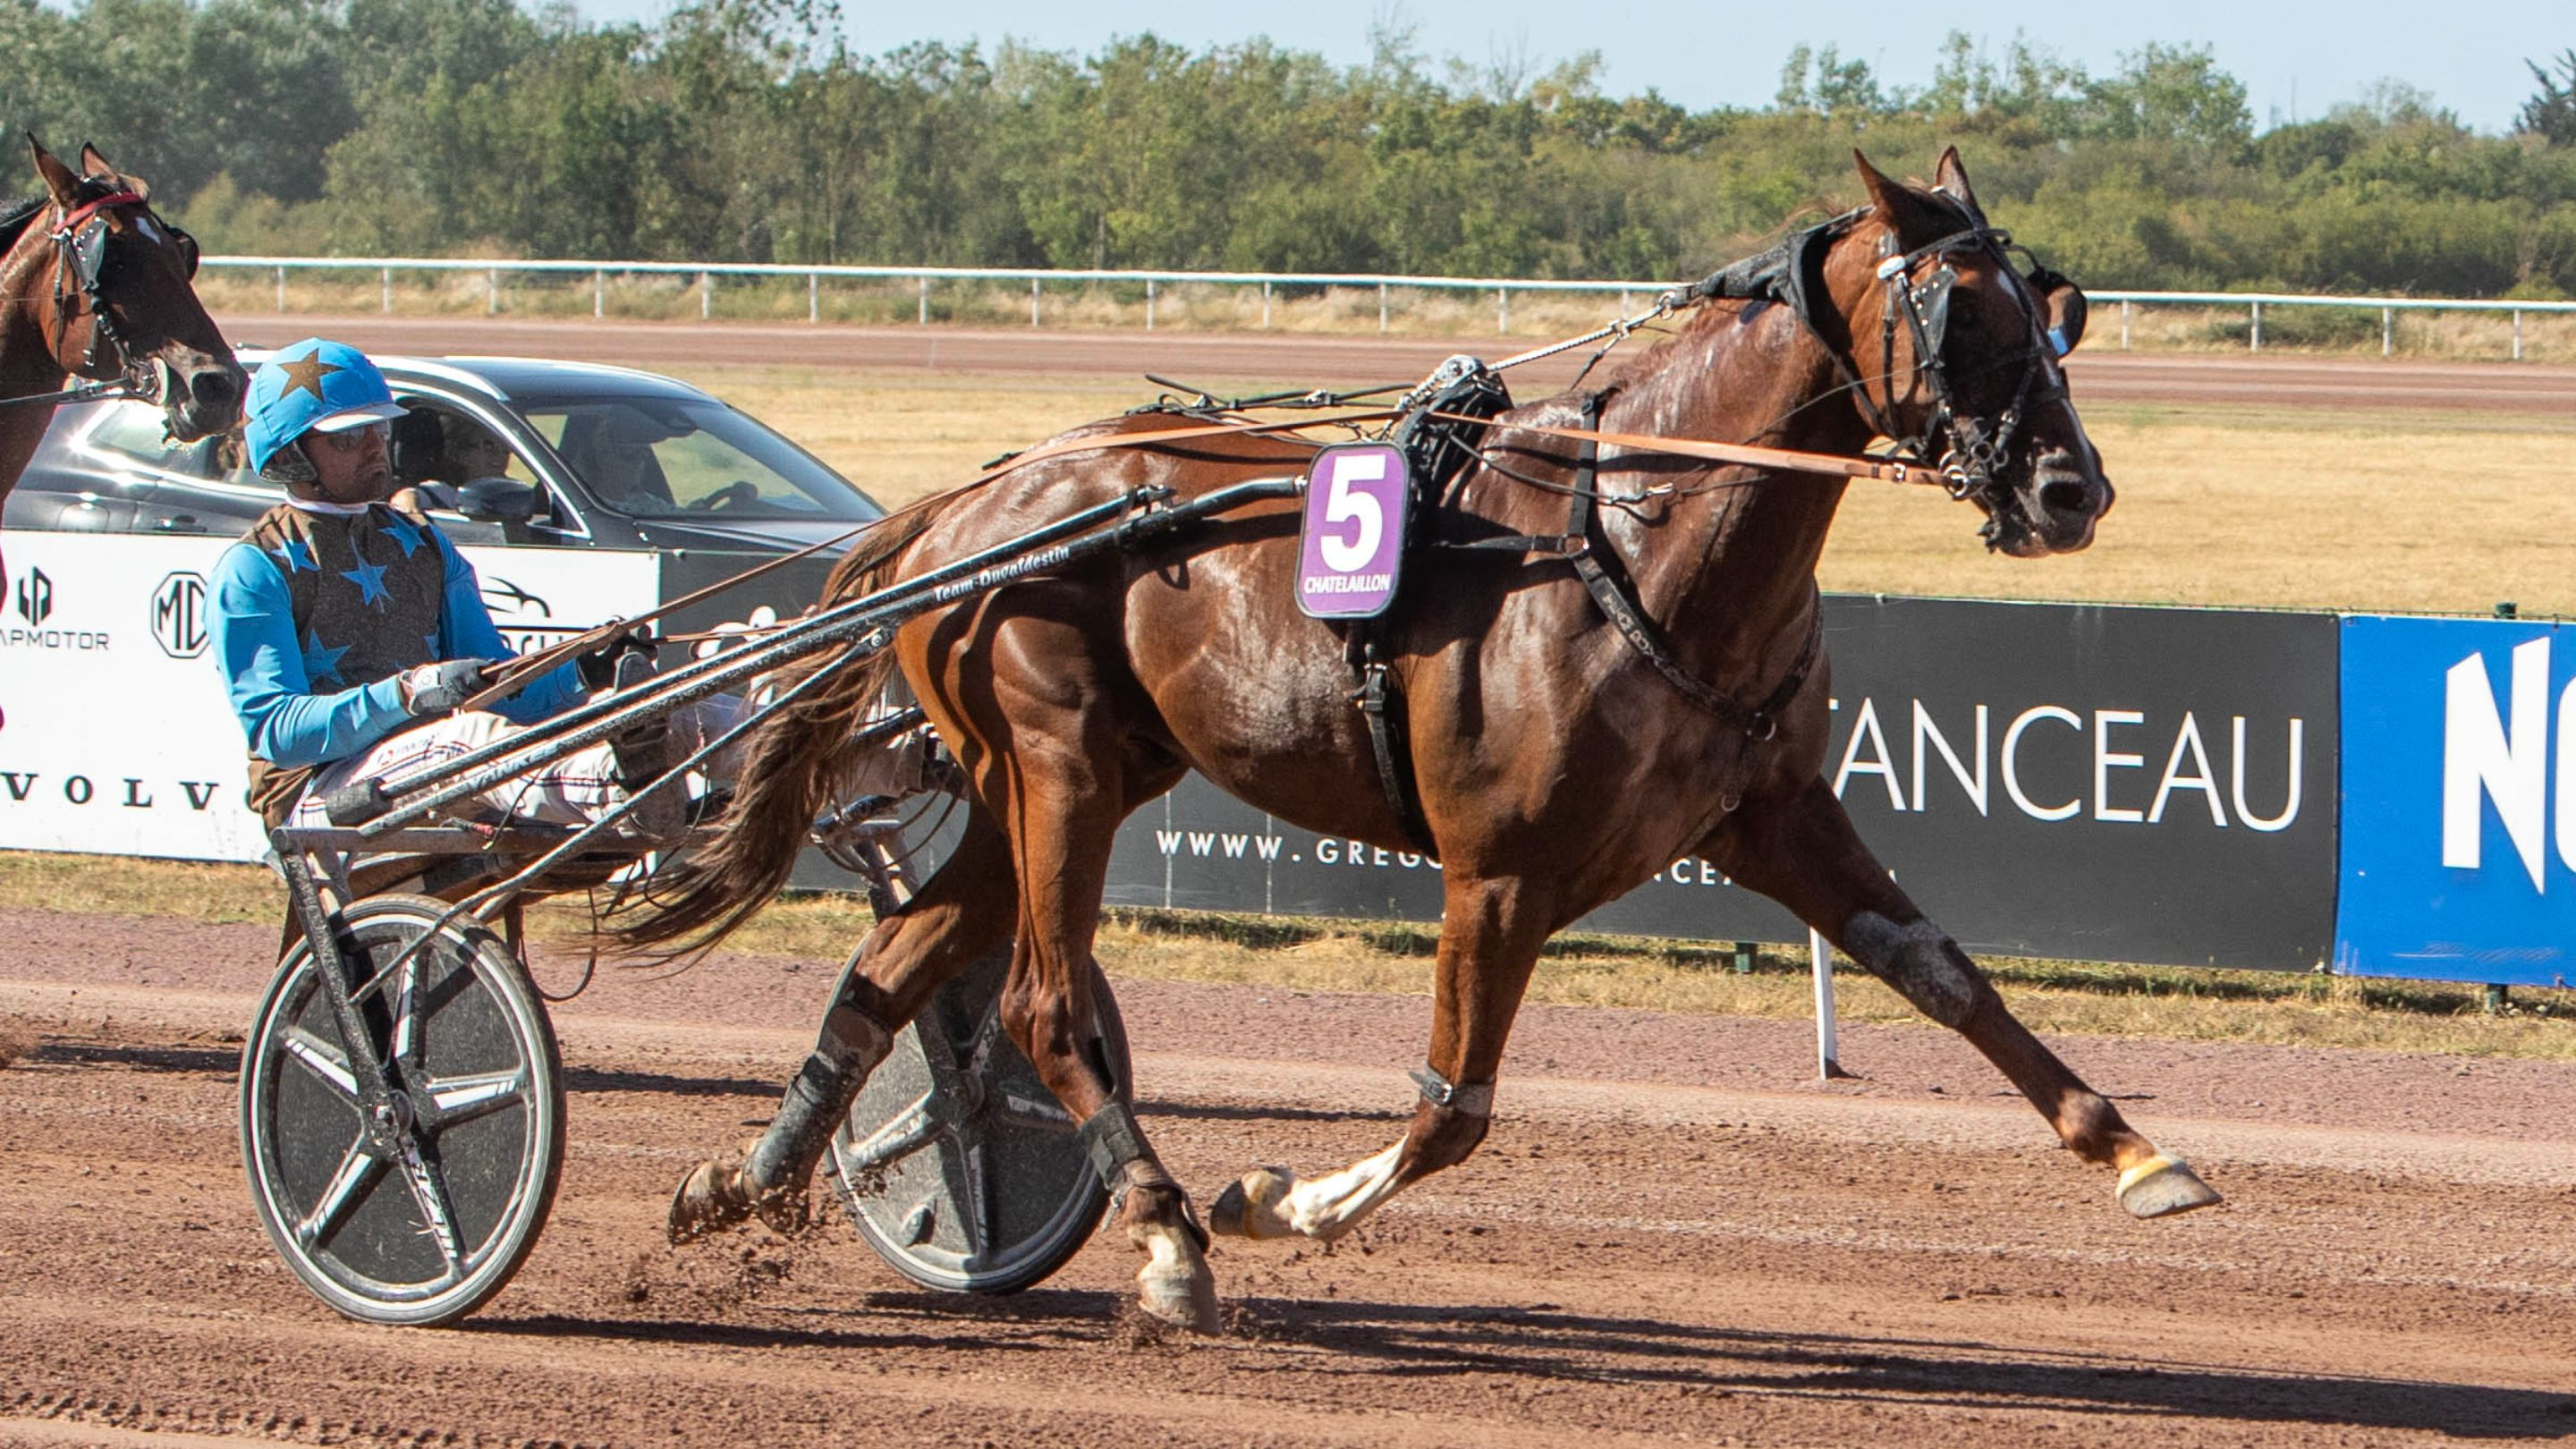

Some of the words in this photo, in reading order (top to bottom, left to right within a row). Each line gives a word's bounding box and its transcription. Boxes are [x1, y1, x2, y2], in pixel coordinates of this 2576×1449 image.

[1320, 454, 1386, 572] 5
[934, 580, 974, 602] Team
[1304, 574, 1391, 594] CHATELAILLON
[0, 772, 259, 813] VOLV
[1829, 697, 2303, 832] ANCEAU
[2443, 636, 2576, 895] N
